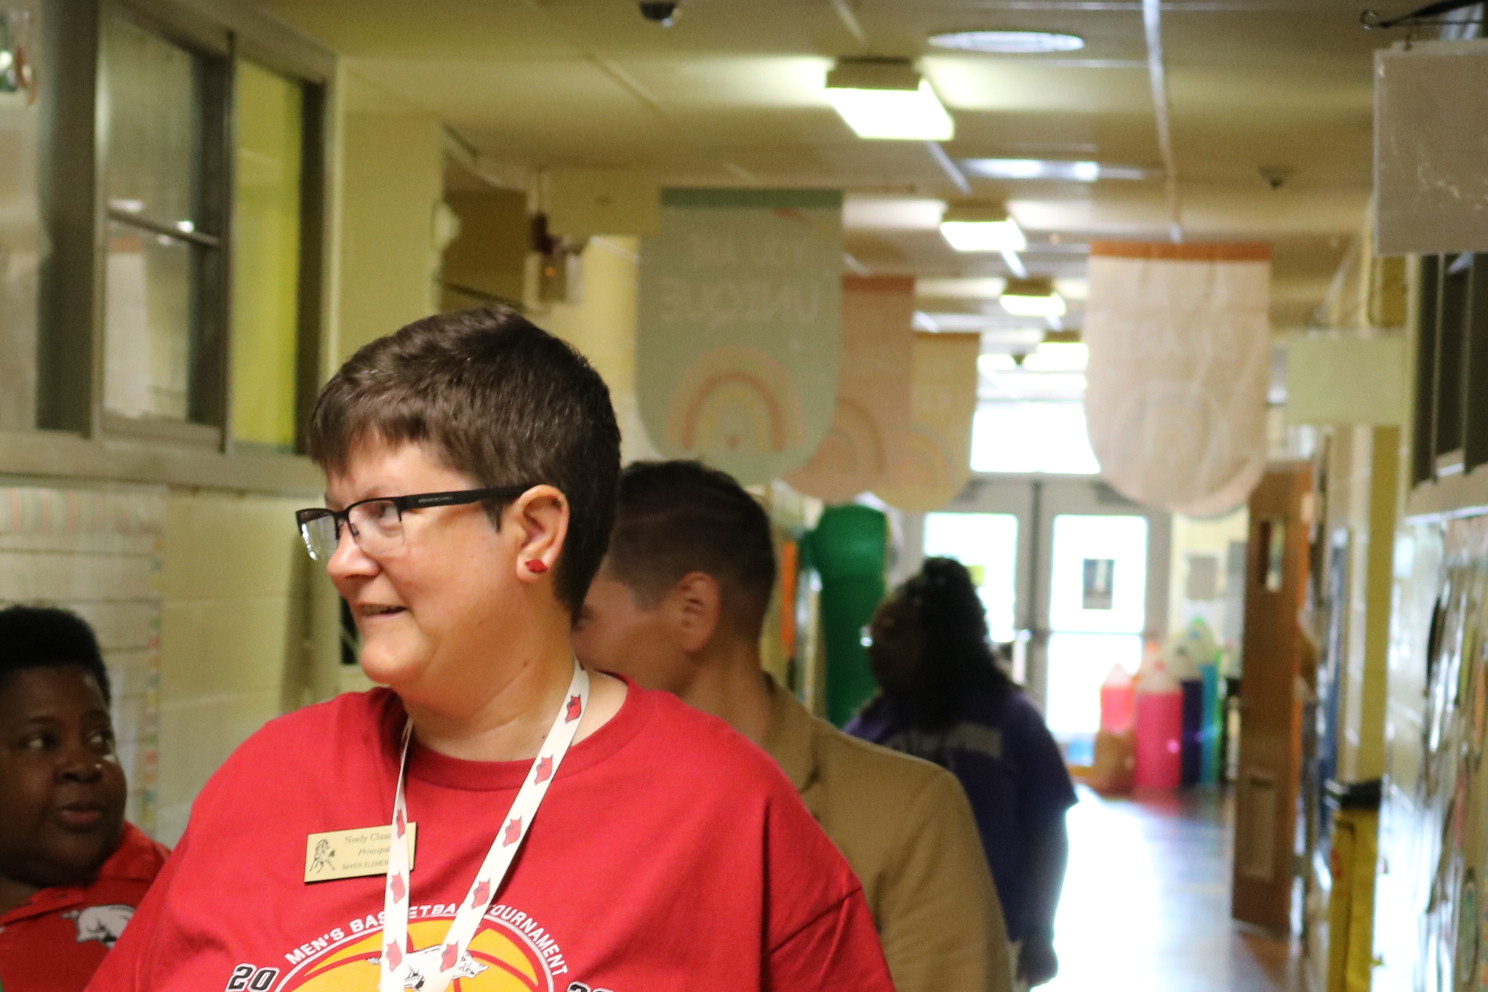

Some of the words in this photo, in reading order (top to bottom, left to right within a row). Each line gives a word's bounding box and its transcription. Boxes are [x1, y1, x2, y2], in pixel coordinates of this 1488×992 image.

[284, 927, 345, 965] MEN'S
[349, 903, 459, 934] BASETBA
[488, 904, 569, 976] OURNAMENT
